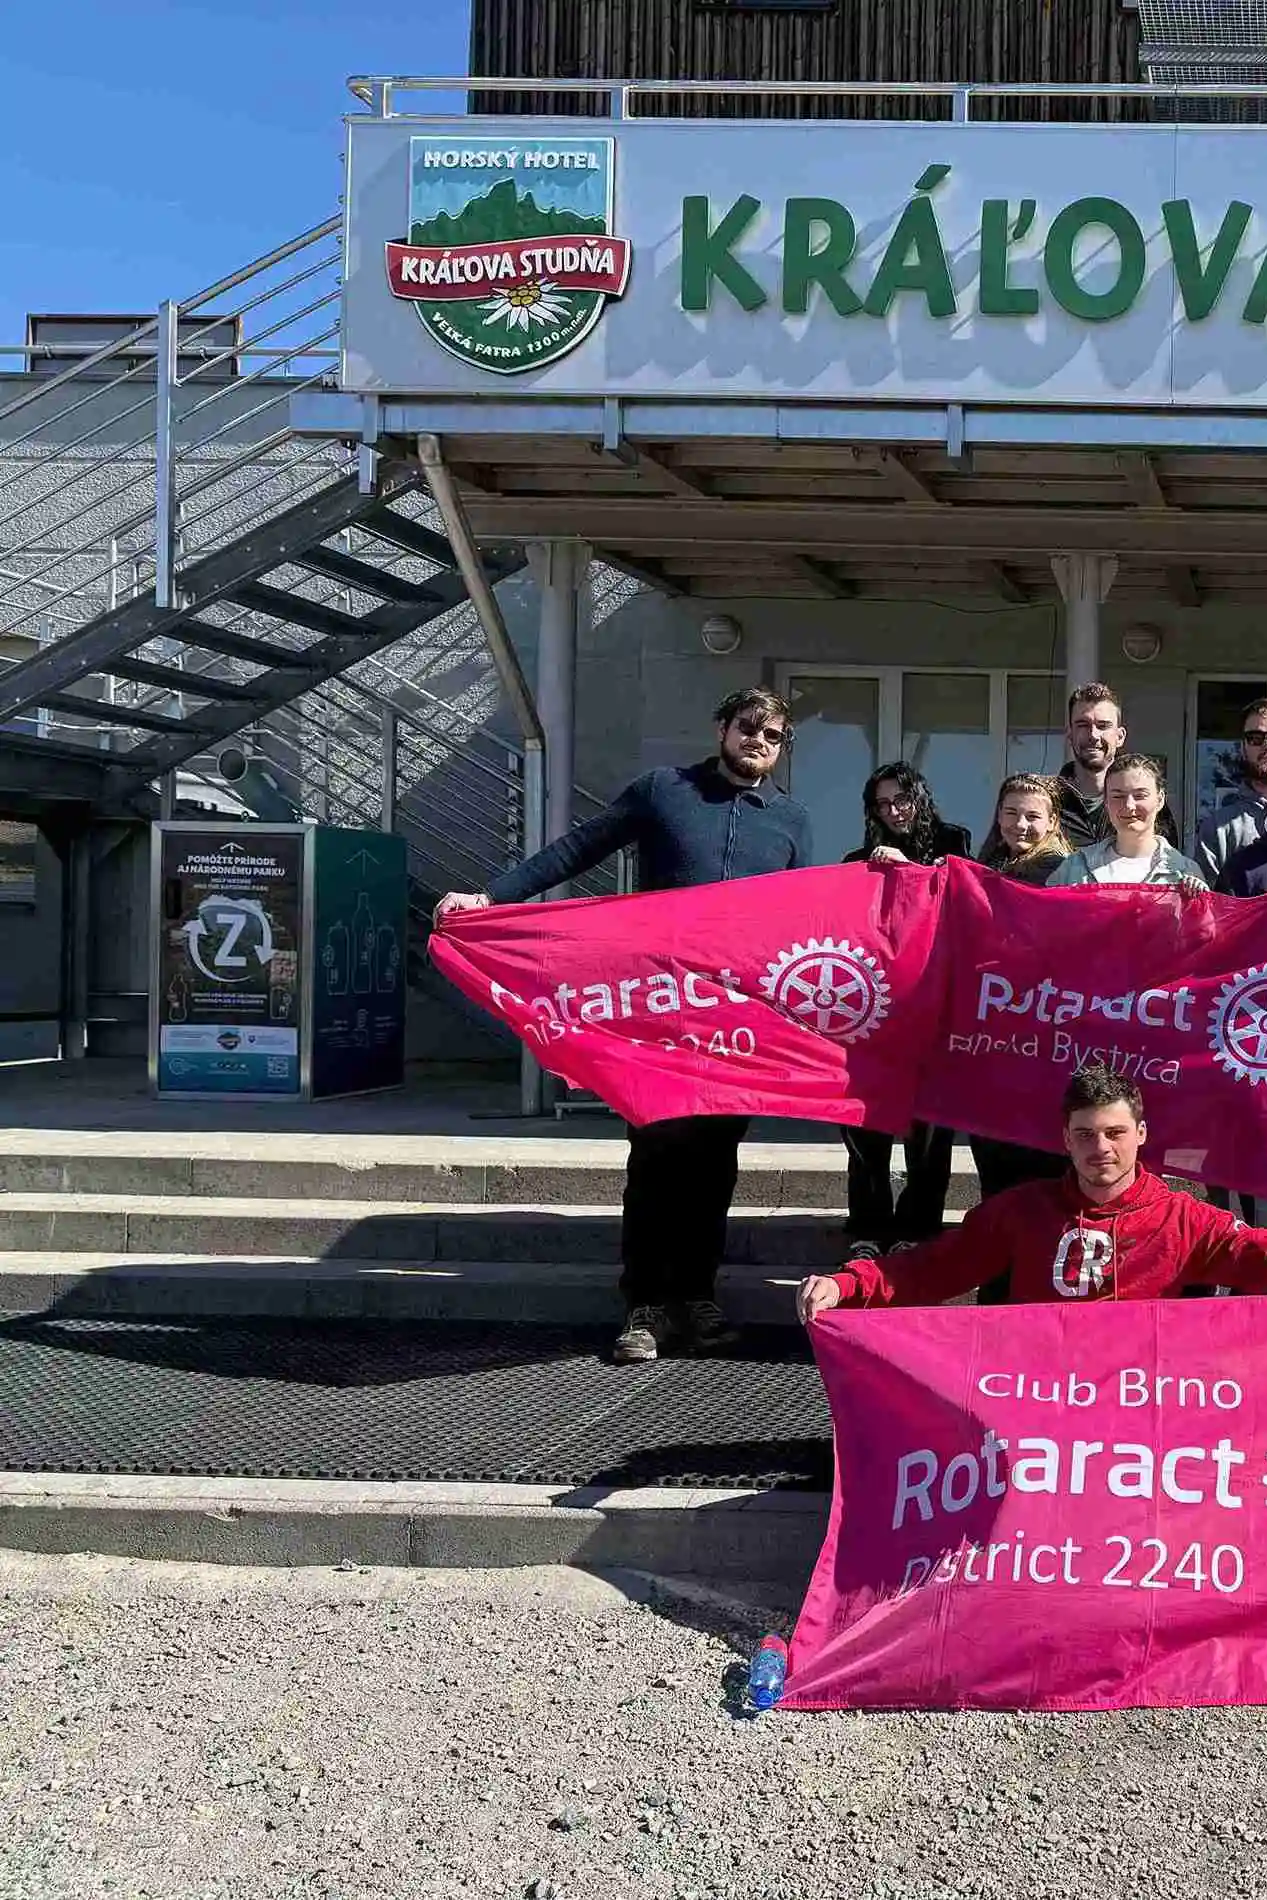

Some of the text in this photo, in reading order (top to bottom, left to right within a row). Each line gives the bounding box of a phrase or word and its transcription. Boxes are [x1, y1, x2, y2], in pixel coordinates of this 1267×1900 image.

[423, 145, 600, 170] HORSKÝ HOTEL
[401, 239, 614, 285] KRÁĽOVA STUDŇA
[474, 343, 521, 358] FATRA
[526, 331, 560, 353] 1300
[977, 1367, 1244, 1410] Club Brno
[892, 1429, 1246, 1531] Rotaract
[1103, 1535, 1245, 1594] 2240
